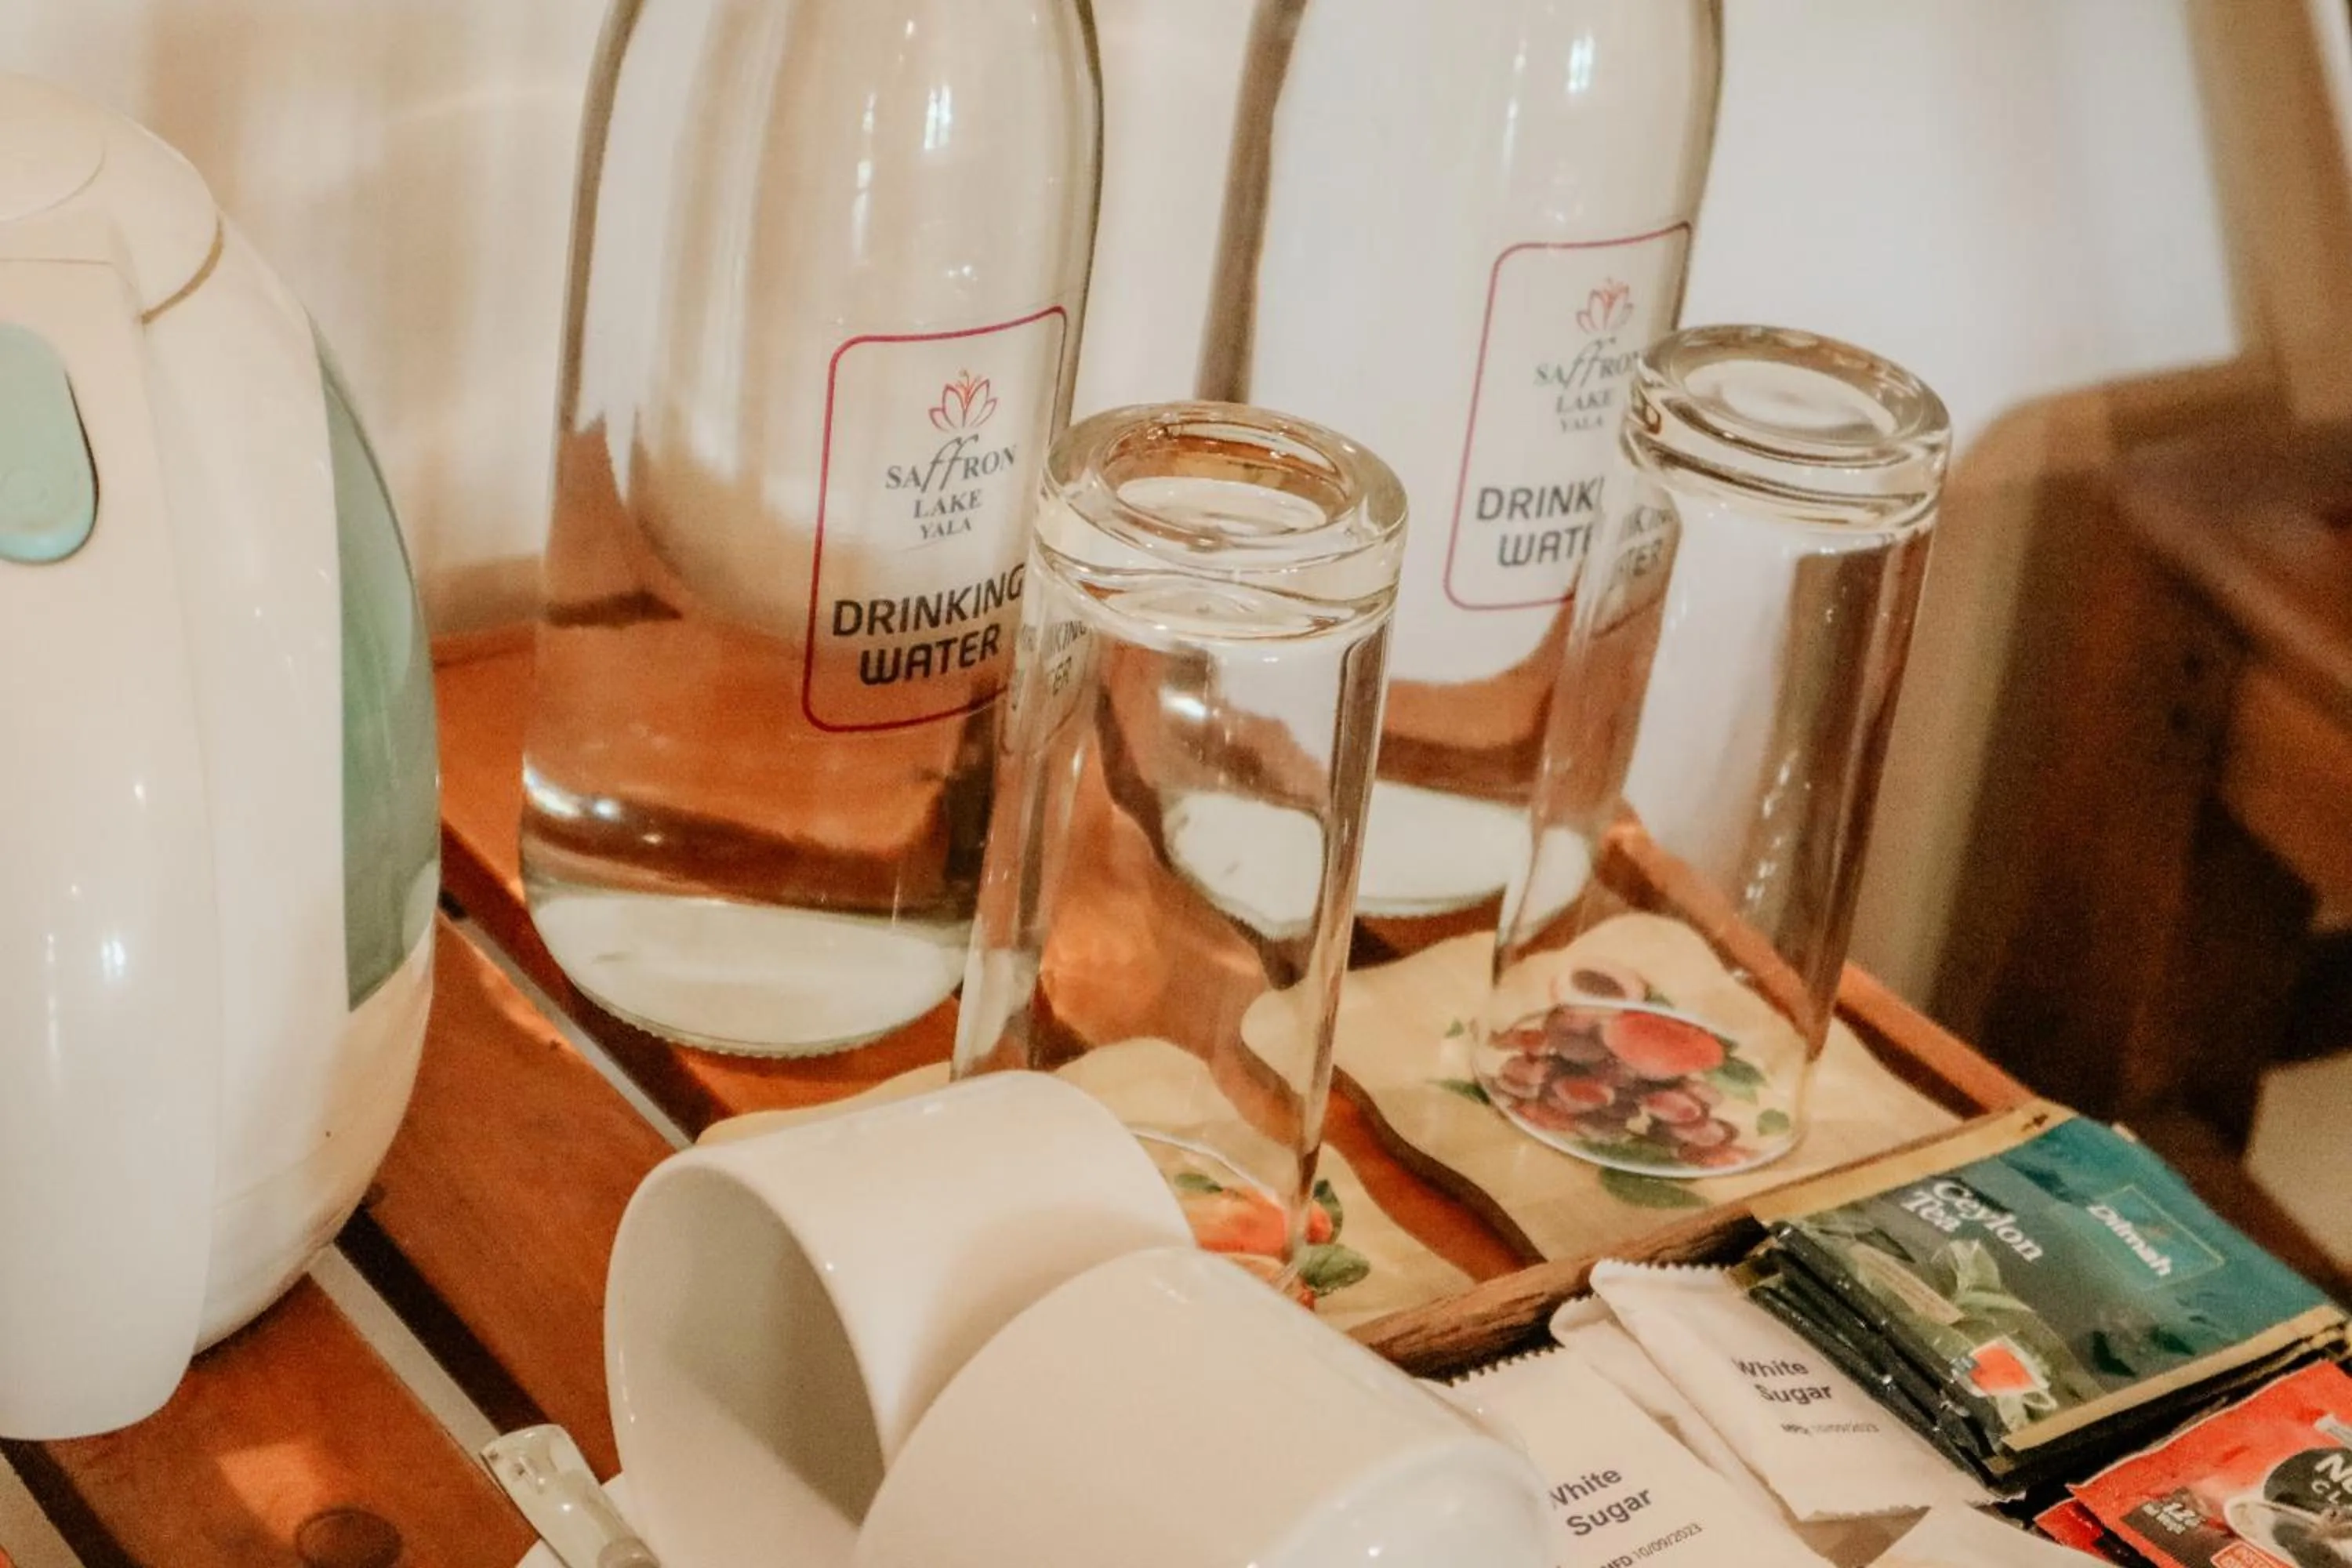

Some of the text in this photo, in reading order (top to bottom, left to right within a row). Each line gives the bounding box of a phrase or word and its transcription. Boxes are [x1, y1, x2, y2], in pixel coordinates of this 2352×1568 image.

[913, 488, 983, 519] LAKE
[1477, 477, 1606, 521] DRINK
[920, 518, 973, 540] YALA
[1498, 522, 1593, 568] WAT
[833, 563, 1025, 637] DRINKING
[860, 624, 1001, 685] WATER
[1900, 1191, 1962, 1233] Tea
[1933, 1178, 2043, 1262] Ceylon
[2086, 1203, 2172, 1277] Dilmah
[1731, 1356, 1809, 1378] White
[1754, 1383, 1833, 1406] Sugar
[1566, 1489, 1653, 1537] Sugar
